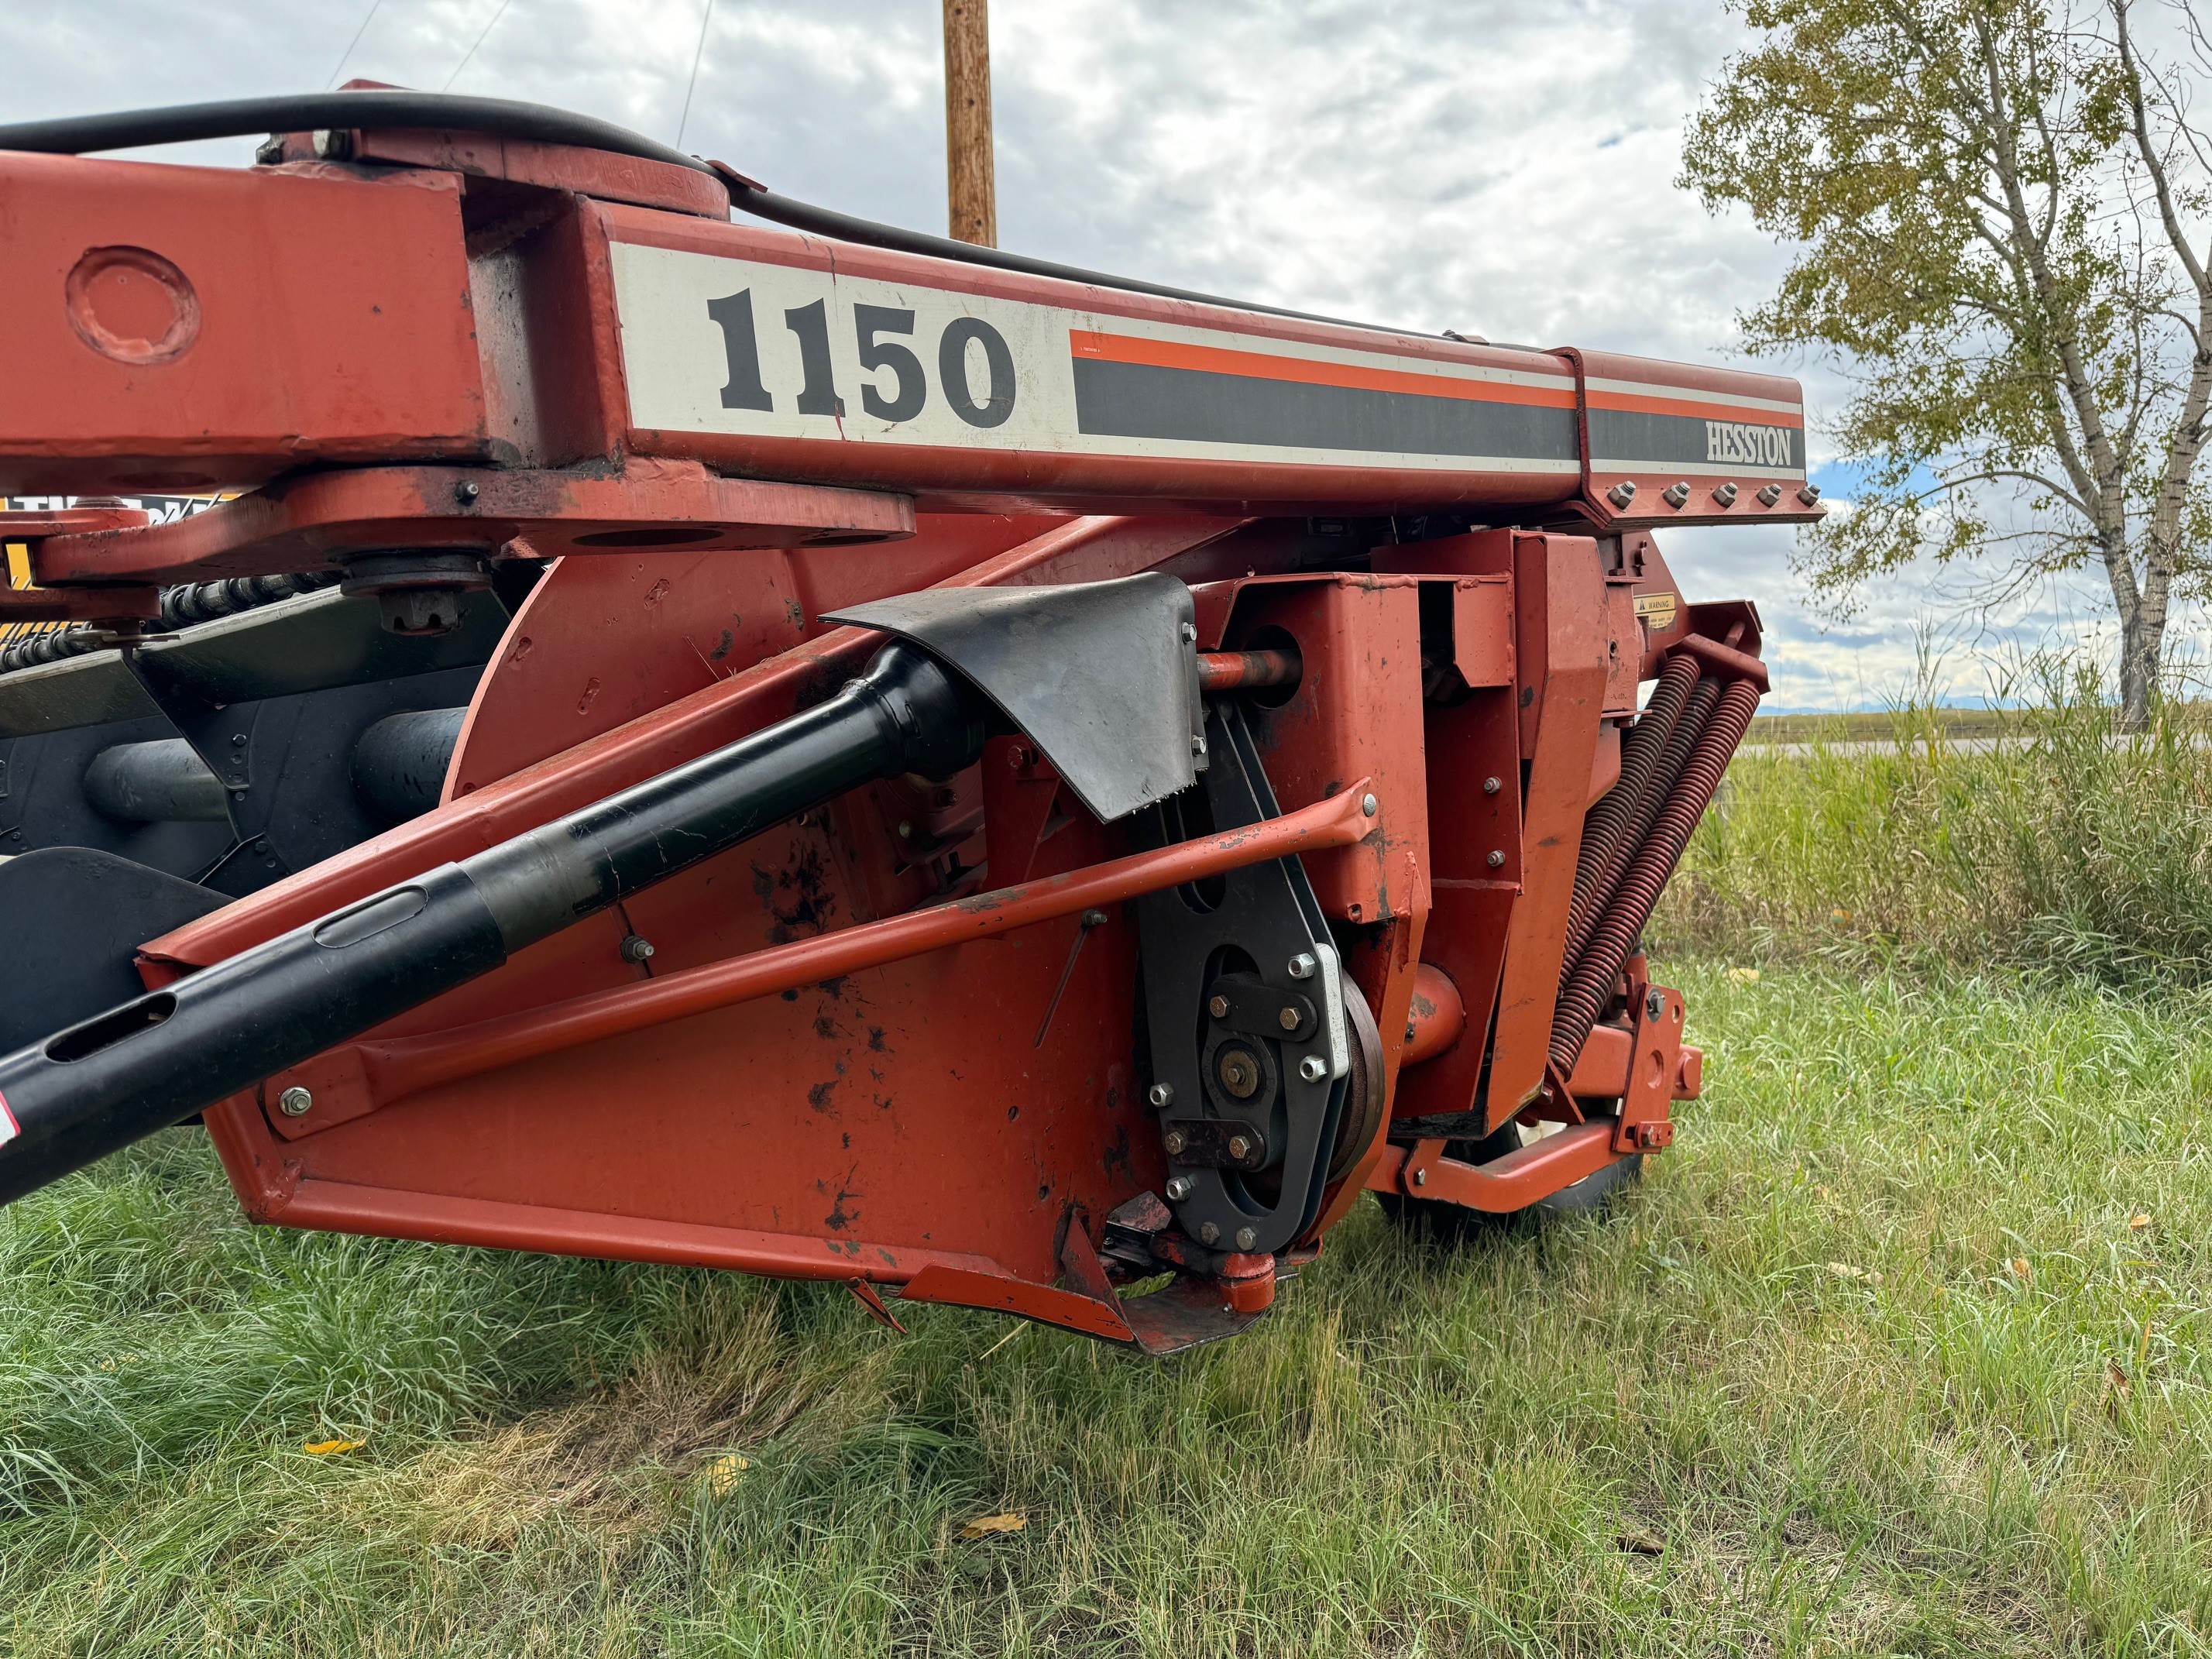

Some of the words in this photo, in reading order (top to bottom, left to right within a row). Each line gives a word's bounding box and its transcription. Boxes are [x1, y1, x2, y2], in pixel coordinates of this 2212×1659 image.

[706, 287, 1016, 429] 1150
[1705, 421, 1791, 466] HESSTON
[1648, 600, 1669, 610] WARNING
